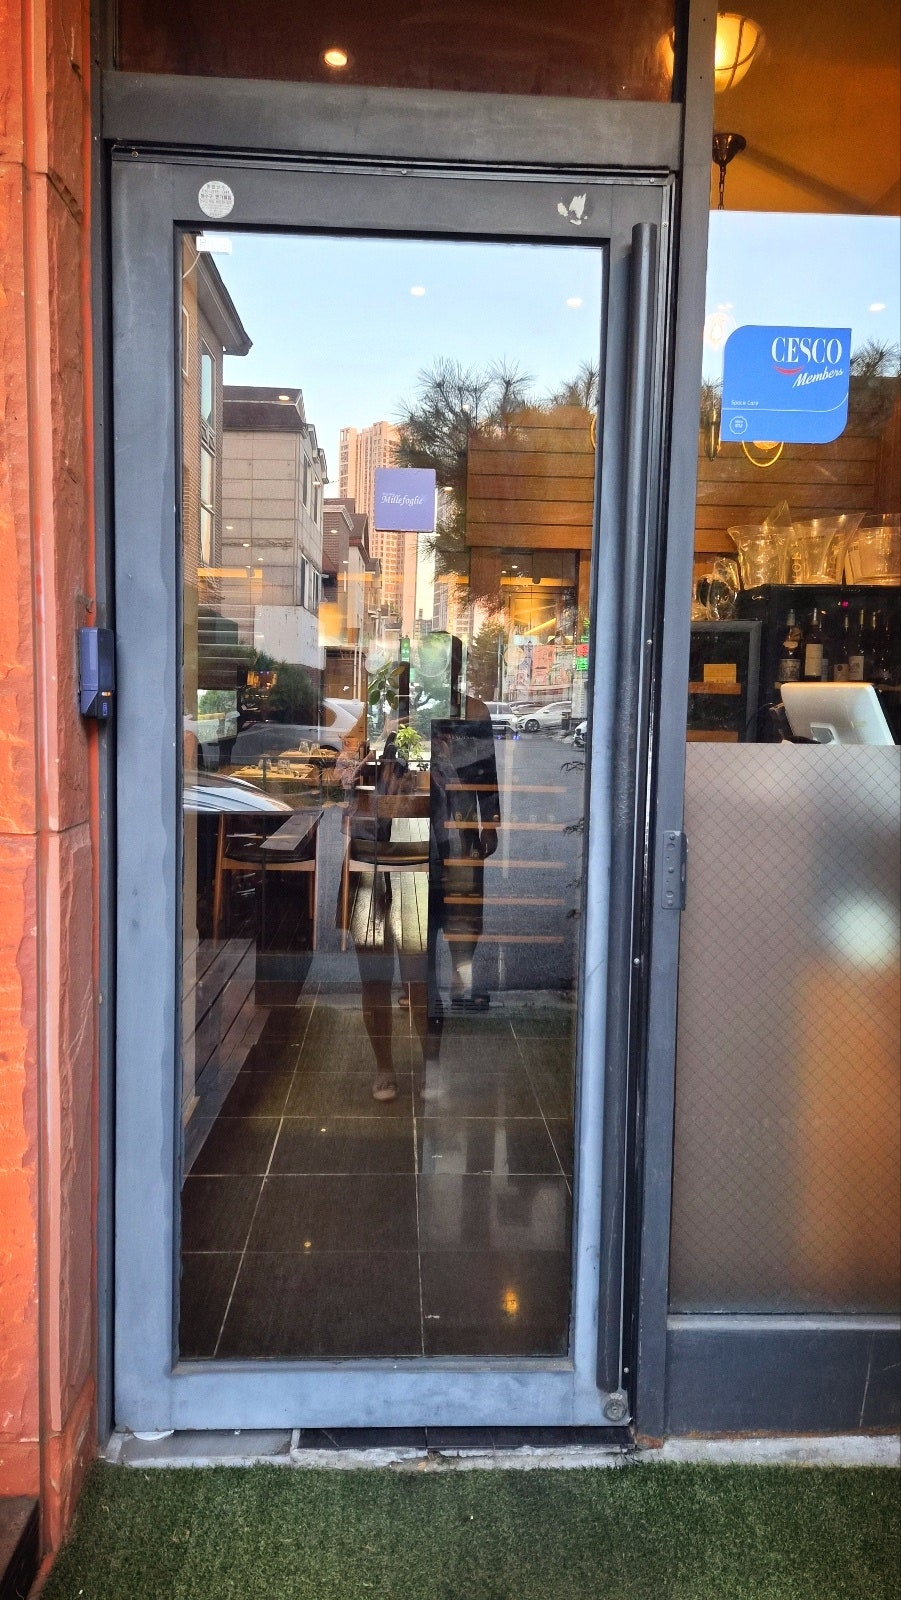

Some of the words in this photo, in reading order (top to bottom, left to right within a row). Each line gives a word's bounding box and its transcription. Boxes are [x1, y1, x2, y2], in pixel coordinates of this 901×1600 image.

[771, 336, 843, 364] CESCO
[792, 366, 844, 389] Members
[381, 495, 424, 506] Millefoglie
